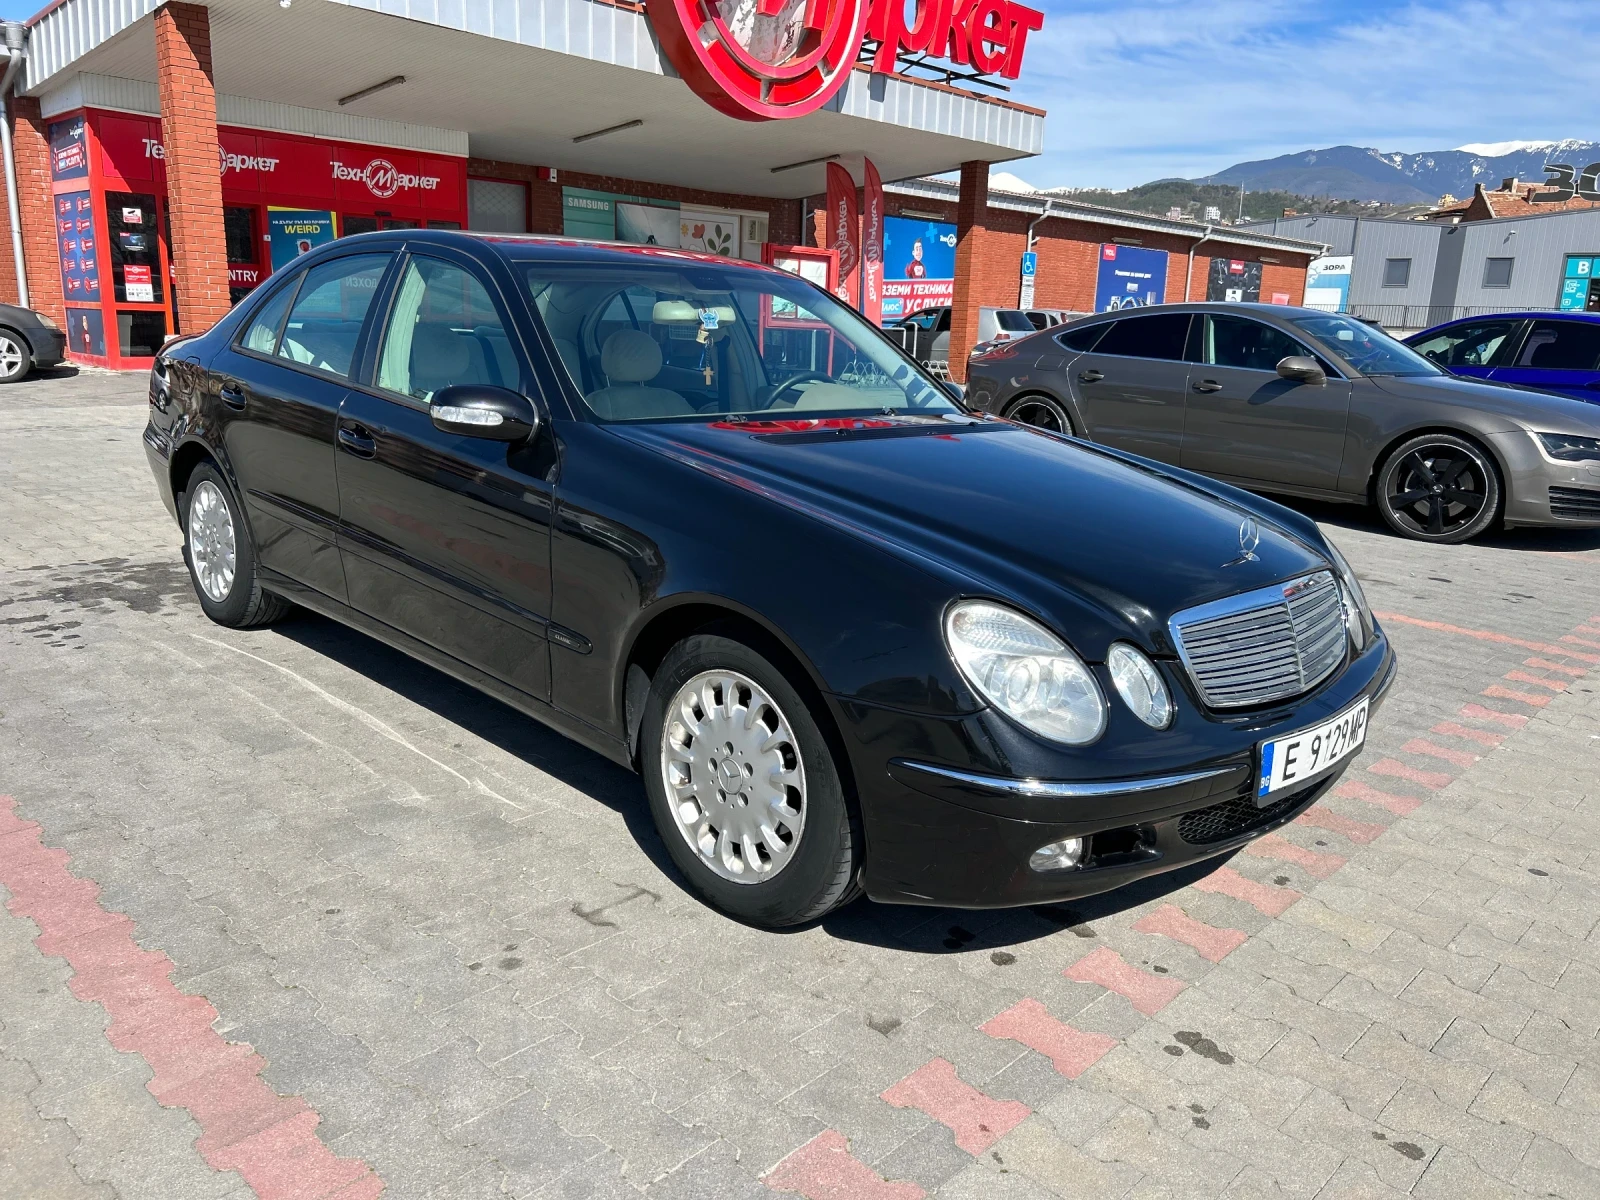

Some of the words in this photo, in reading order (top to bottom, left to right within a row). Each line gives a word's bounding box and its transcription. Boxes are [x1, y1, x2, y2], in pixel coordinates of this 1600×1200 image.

[568, 197, 609, 211] SAMSUNG
[284, 225, 320, 234] WEIRD
[228, 269, 258, 282] NTRY
[913, 283, 953, 295] ТЕХНИКА
[1282, 741, 1300, 782] E
[1310, 719, 1349, 771] 9129
[1260, 777, 1271, 788] BG
